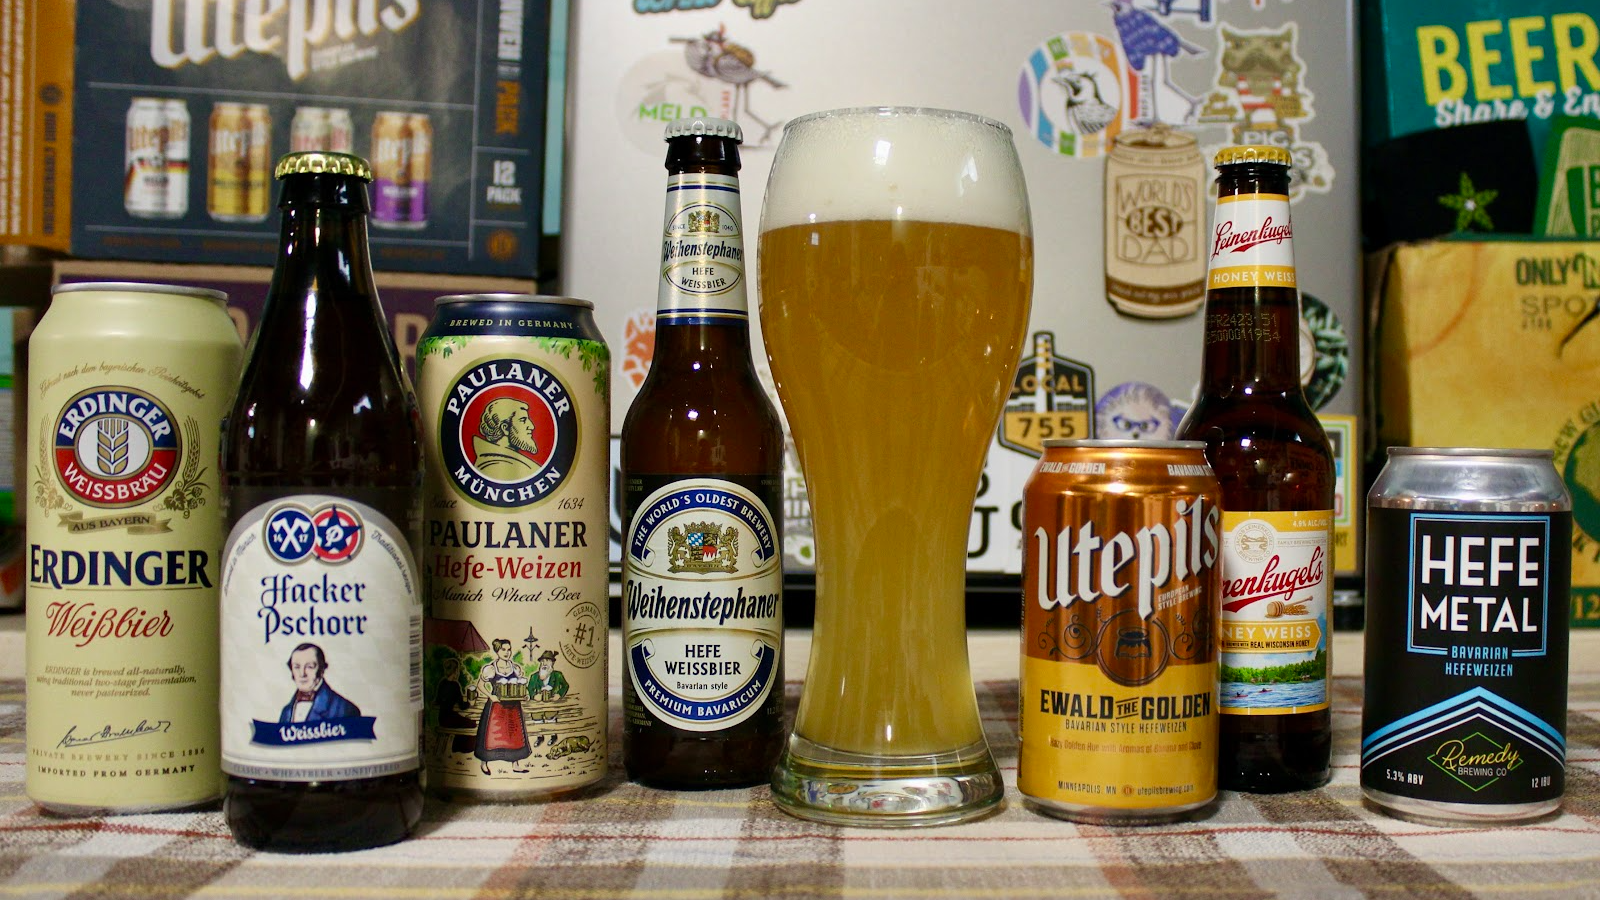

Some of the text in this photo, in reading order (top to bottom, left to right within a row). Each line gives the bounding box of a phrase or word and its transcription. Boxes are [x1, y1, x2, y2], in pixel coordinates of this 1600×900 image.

[1435, 97, 1529, 127] Share
[1533, 89, 1555, 119] &
[493, 160, 516, 186] 12
[486, 186, 522, 204] PACK
[1129, 206, 1181, 238] BEST
[1124, 235, 1189, 262] DAD
[692, 267, 714, 276] HEFE
[1214, 271, 1296, 284] HONEY WEISS
[1516, 257, 1570, 287] ONLY
[681, 277, 727, 289] WEISSBIER
[449, 319, 493, 327] BREWED
[518, 319, 573, 330] GERMANY
[447, 363, 570, 417] PAULANER
[1012, 374, 1084, 393] LOCAL
[59, 393, 172, 440] ERDINGER
[1018, 417, 1076, 438] 755
[1040, 462, 1062, 473] EWALD
[1069, 463, 1105, 475] GOLDEN
[1167, 464, 1204, 476] BAVARIAN
[64, 462, 168, 501] WEISSBRÄU
[454, 465, 562, 503] MÜNCHEN
[557, 497, 584, 510] 1634
[72, 516, 150, 532] AUS BAYERN
[634, 493, 772, 550] THE WORLD'S OLDEST BREWERY
[299, 534, 308, 543] 17
[430, 520, 588, 548] PAULANER
[30, 544, 213, 590] ERDINGER
[1034, 494, 1220, 622] Utepils
[1422, 535, 1540, 587] HEFE
[434, 554, 582, 586] Hefe-Weizen
[260, 573, 366, 607] Hacker
[433, 586, 582, 602] Munich Wheat Beer
[1158, 584, 1190, 603] EUROPEAN
[626, 579, 779, 625] Weihenstephaner
[1158, 597, 1178, 611] STYLE
[1420, 593, 1538, 633] METAL
[46, 601, 174, 648] Weißbier
[257, 606, 367, 645] Pschorr
[1263, 626, 1311, 639] WEISS
[573, 623, 595, 648] #1
[1265, 640, 1295, 649] WISCONSIN
[685, 644, 721, 658] HEFE
[1452, 645, 1509, 660] BAVARIAN
[45, 665, 186, 676] ERDINGER is brewed all-naturally,
[665, 661, 741, 676] WEISSBIER
[1445, 662, 1513, 677] HEFEWEIZEN
[52, 676, 93, 687] traditional
[95, 678, 137, 688] two-stage
[137, 675, 197, 687] fermentation,
[676, 681, 728, 691] Bavarian style
[71, 688, 151, 699] never pasteurized.
[645, 679, 692, 716] PREMIUM
[697, 680, 762, 717] BAVARICUM
[1040, 689, 1211, 720] EWALD THE GOLDEN
[279, 722, 347, 742] Weissbier
[1065, 719, 1187, 734] BAVARIAN STYLE HEFEWEIZEN
[32, 748, 65, 760] PRIVATE
[71, 754, 129, 762] BREWERY
[137, 751, 175, 761] SINCE
[1087, 742, 1099, 751] Hue
[1436, 739, 1519, 771] Remedy
[38, 765, 87, 777] IMPORTED
[135, 765, 196, 777] GERMANY
[1386, 769, 1424, 786] 5.3% ABV
[1457, 766, 1507, 776] BREWING CO
[1105, 786, 1117, 795] MN
[1531, 776, 1551, 788] 12 IBU
